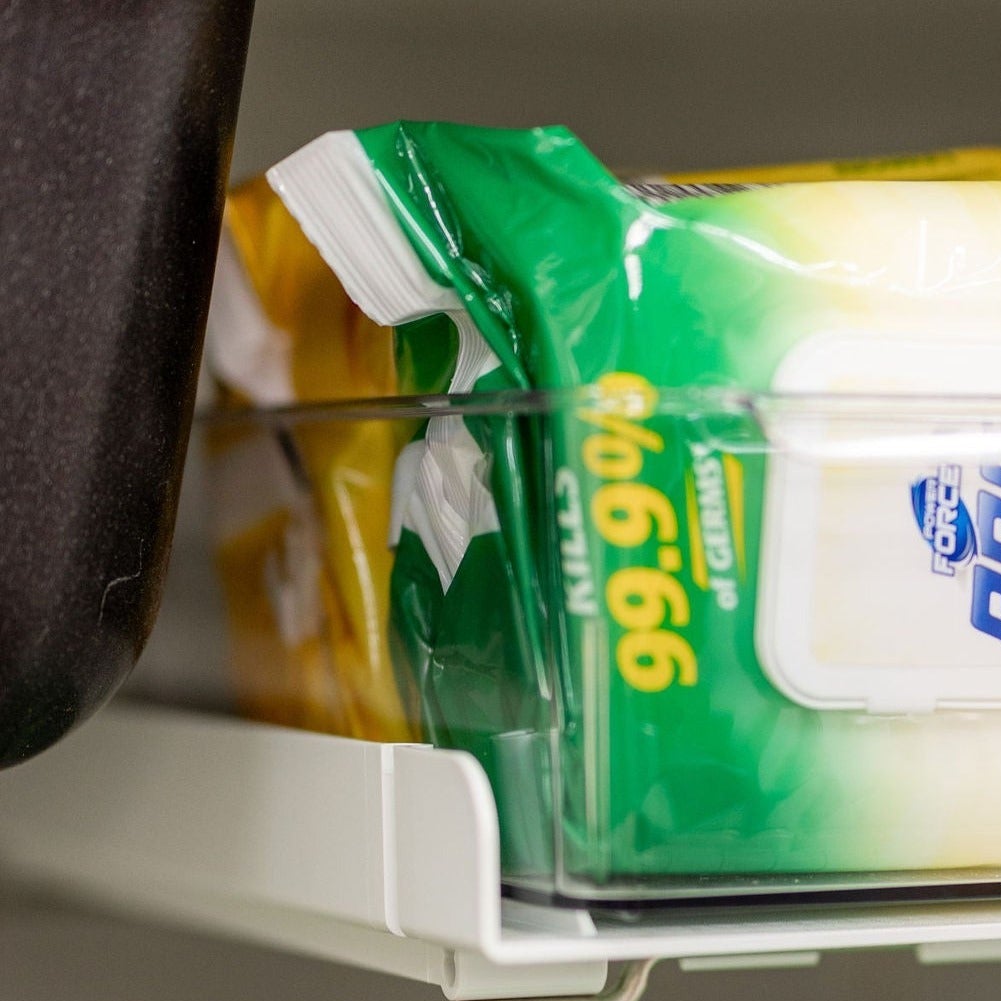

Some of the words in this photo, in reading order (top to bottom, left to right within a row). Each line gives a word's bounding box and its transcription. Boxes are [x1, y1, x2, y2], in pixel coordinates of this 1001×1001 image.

[577, 372, 698, 692] 99.9%
[931, 464, 962, 578] FORCE
[710, 576, 739, 611] of
